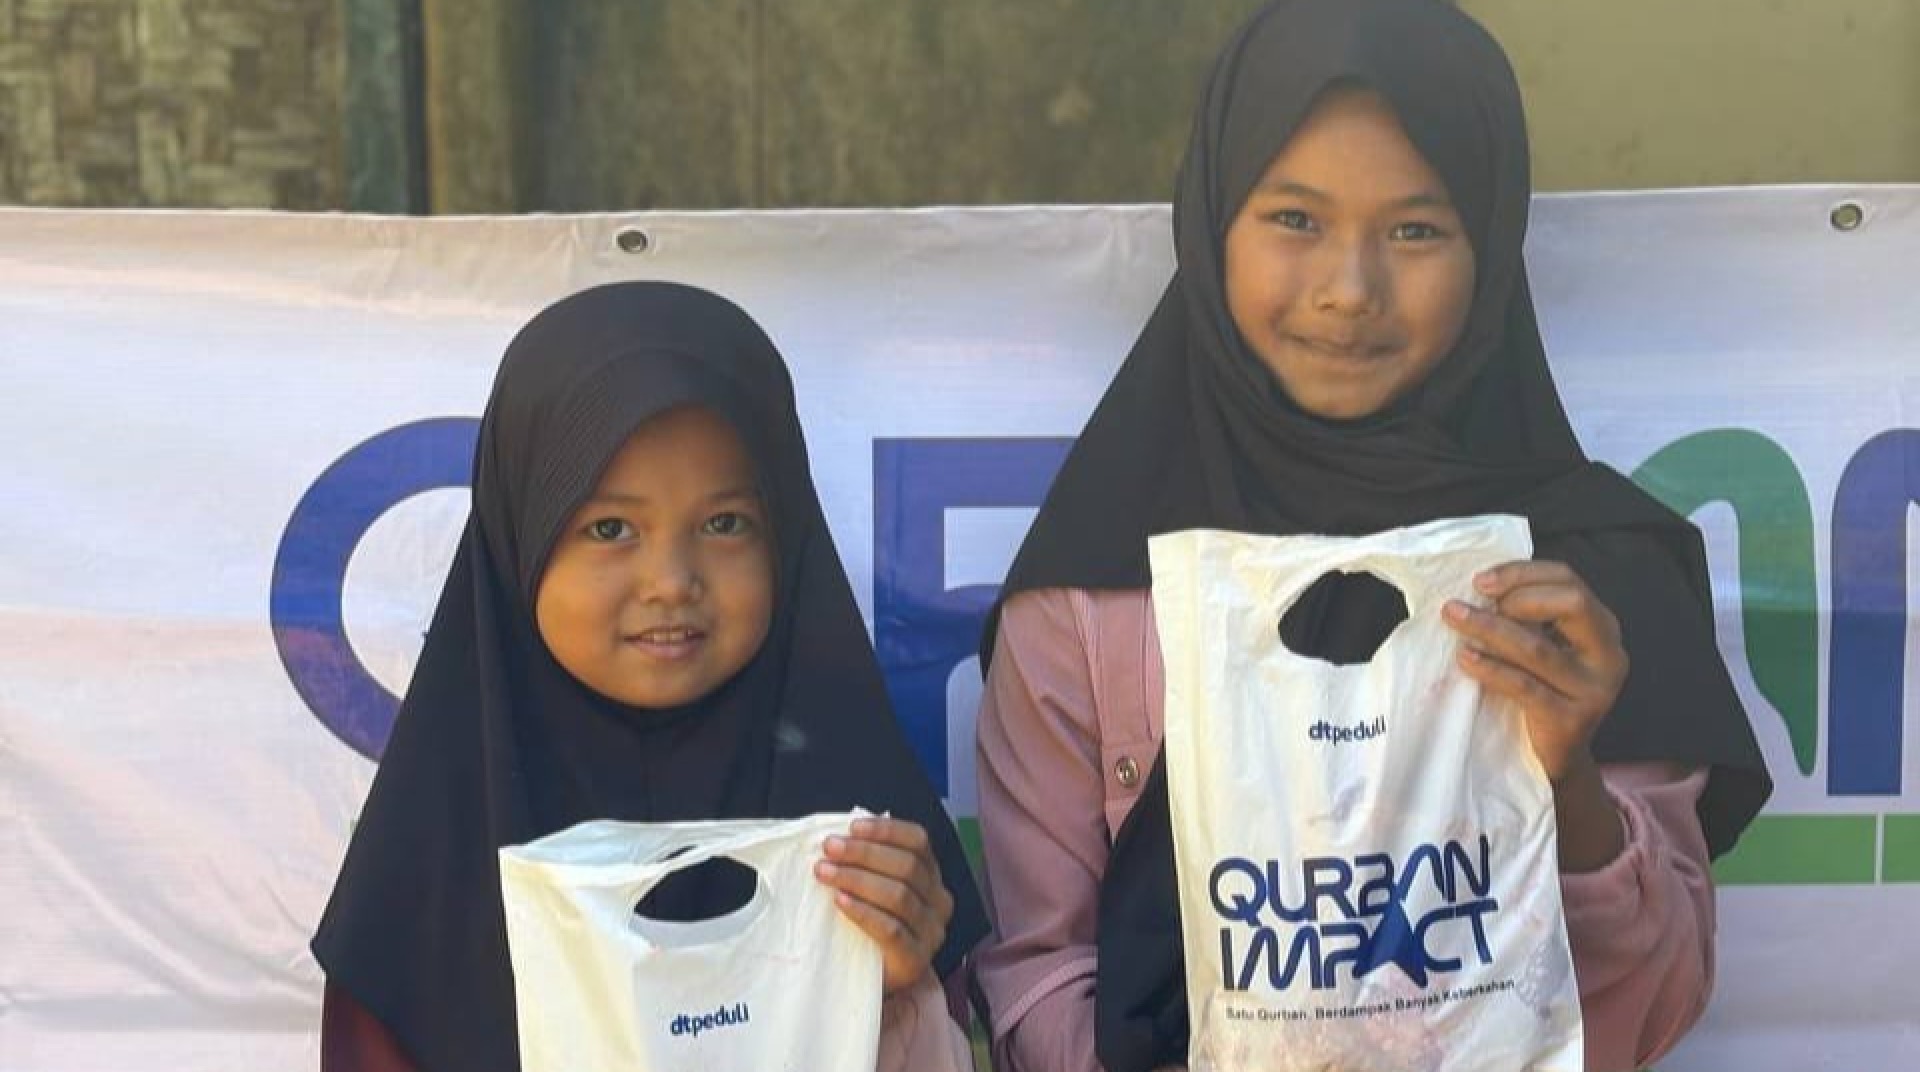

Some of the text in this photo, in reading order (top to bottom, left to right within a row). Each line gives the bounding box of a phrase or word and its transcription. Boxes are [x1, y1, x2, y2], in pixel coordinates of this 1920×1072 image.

[1308, 714, 1387, 747] dtpeduli
[1209, 834, 1491, 927] QURBAN
[1220, 893, 1498, 991] IMPACT
[670, 1002, 750, 1038] dtpeduli
